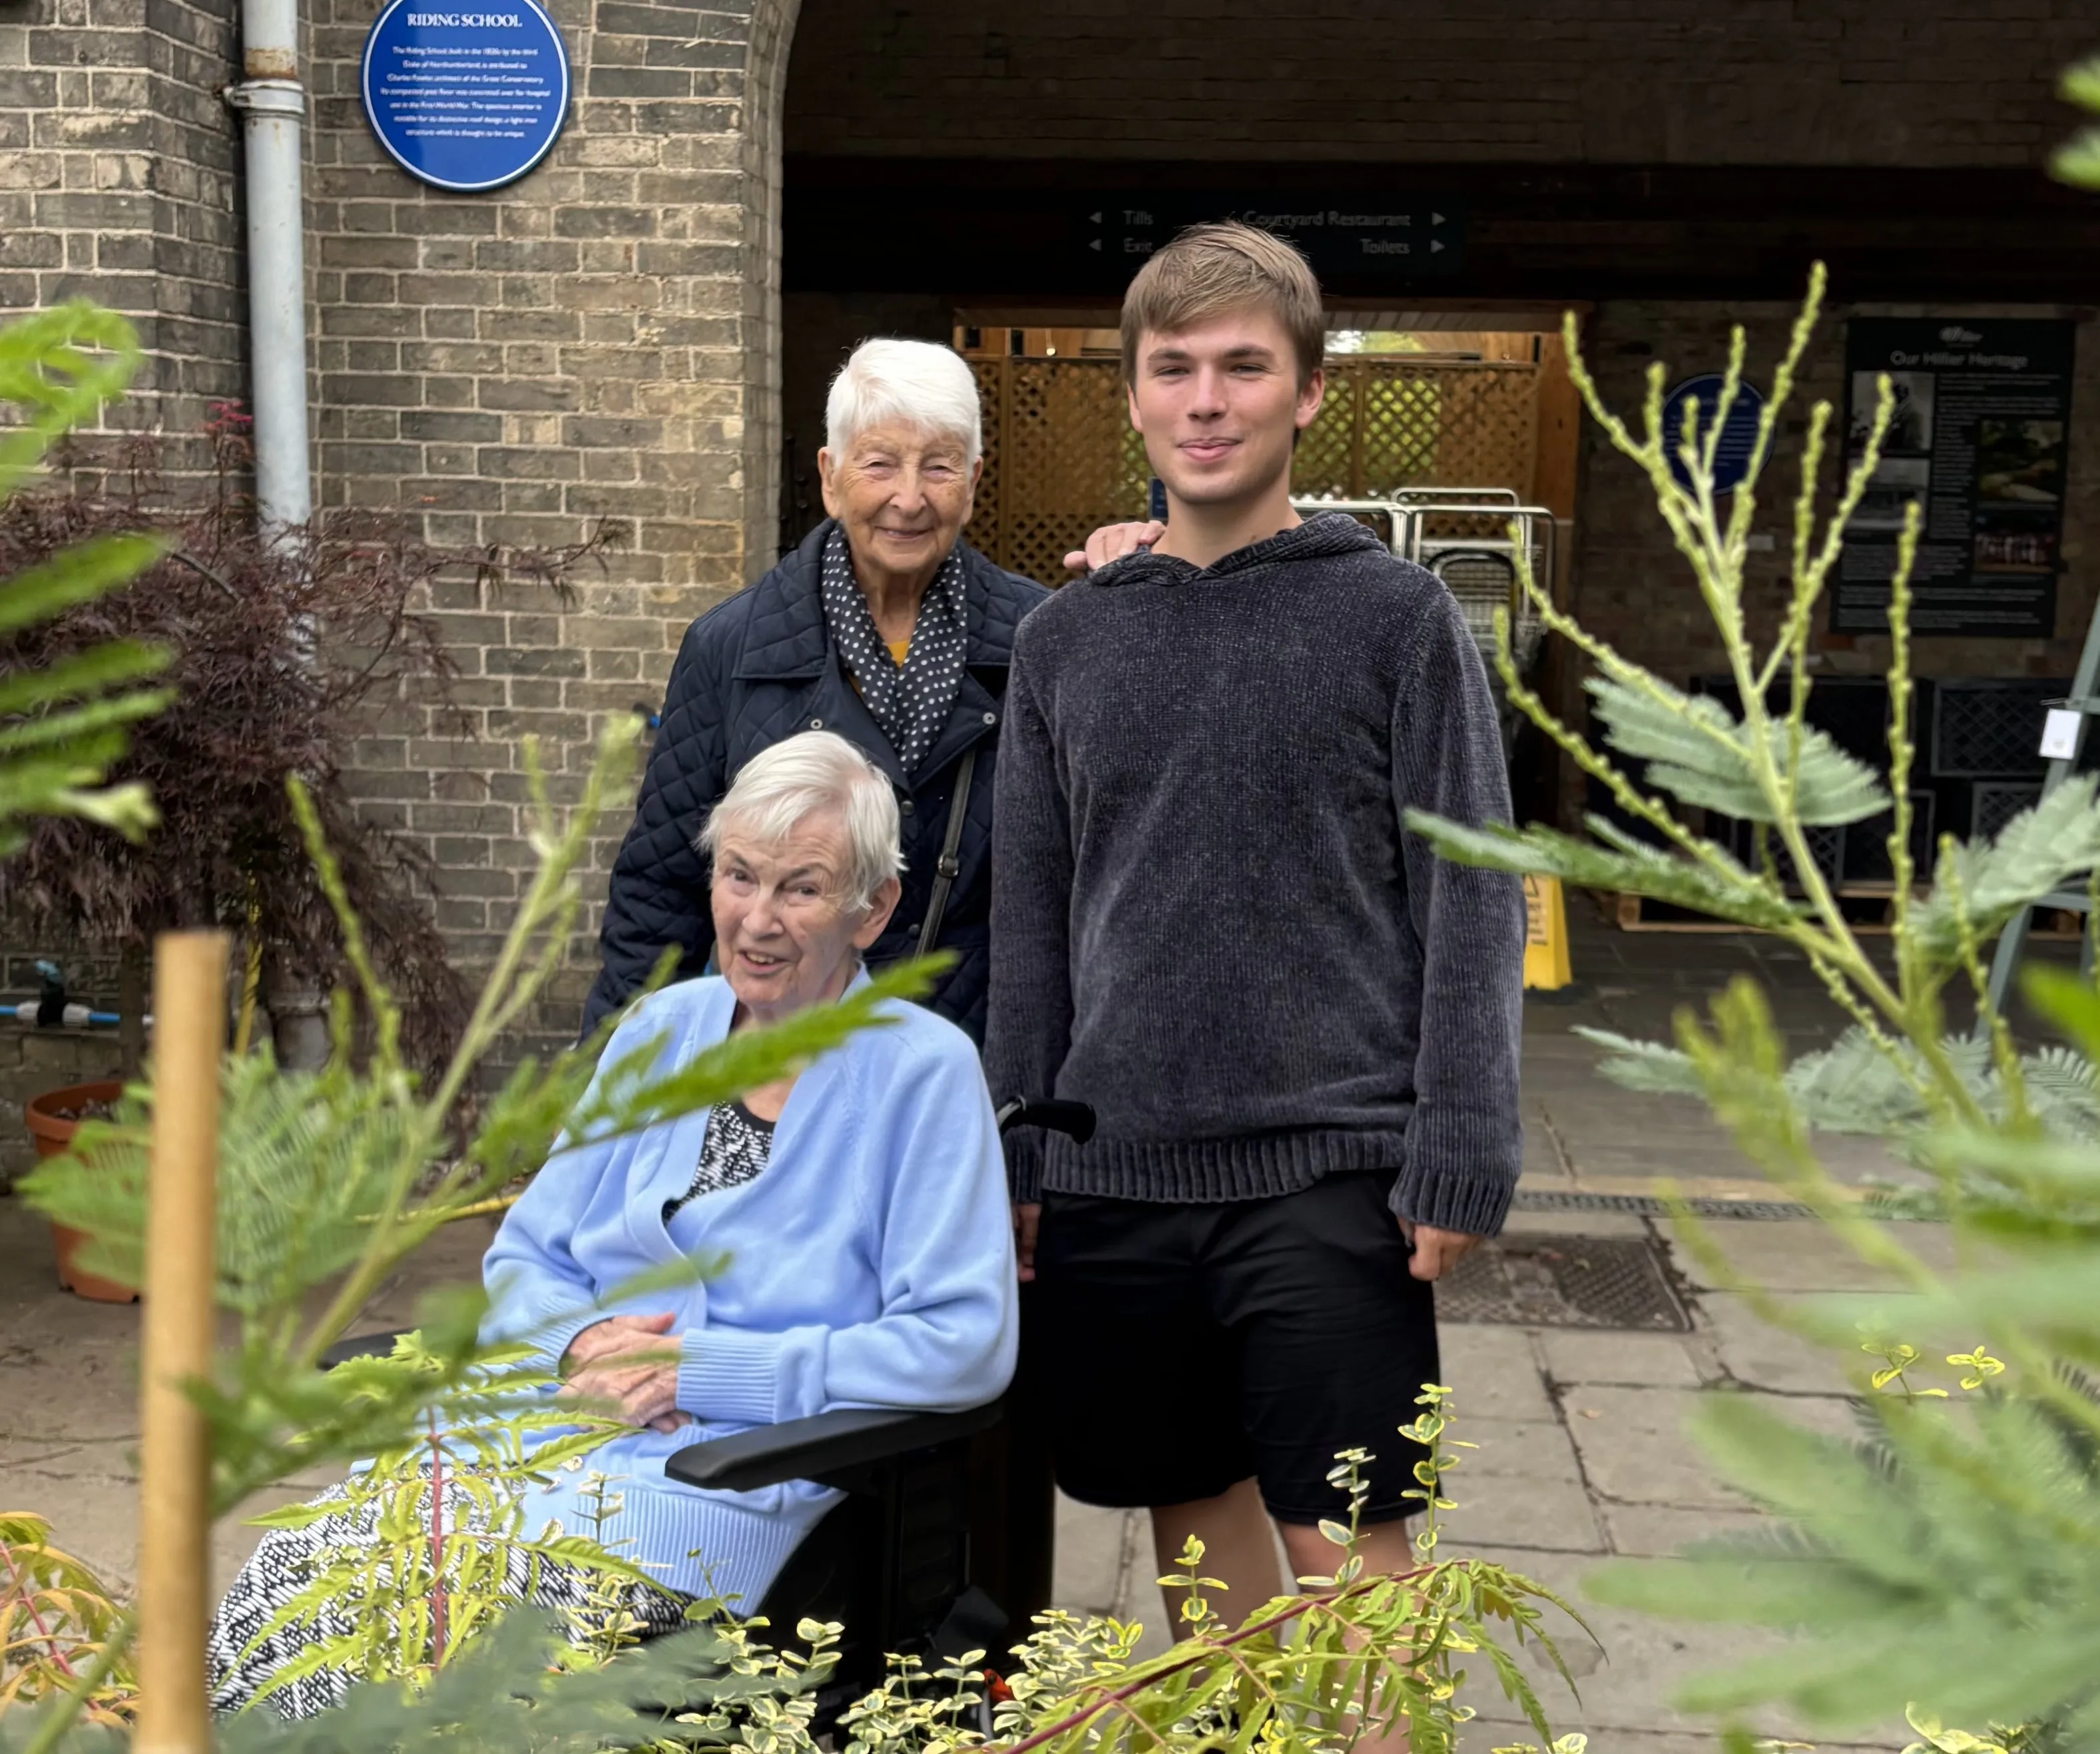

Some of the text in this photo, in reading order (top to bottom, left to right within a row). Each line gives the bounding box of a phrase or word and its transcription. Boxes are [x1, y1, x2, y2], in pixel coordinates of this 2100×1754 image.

[407, 13, 523, 27] RIDING SCHOOL
[1122, 210, 1154, 225] Tills
[1242, 210, 1411, 229] Courtyard Restaurant
[1123, 237, 1153, 253] Exit
[1360, 238, 1410, 254] Toilets
[1890, 350, 1919, 366] Our
